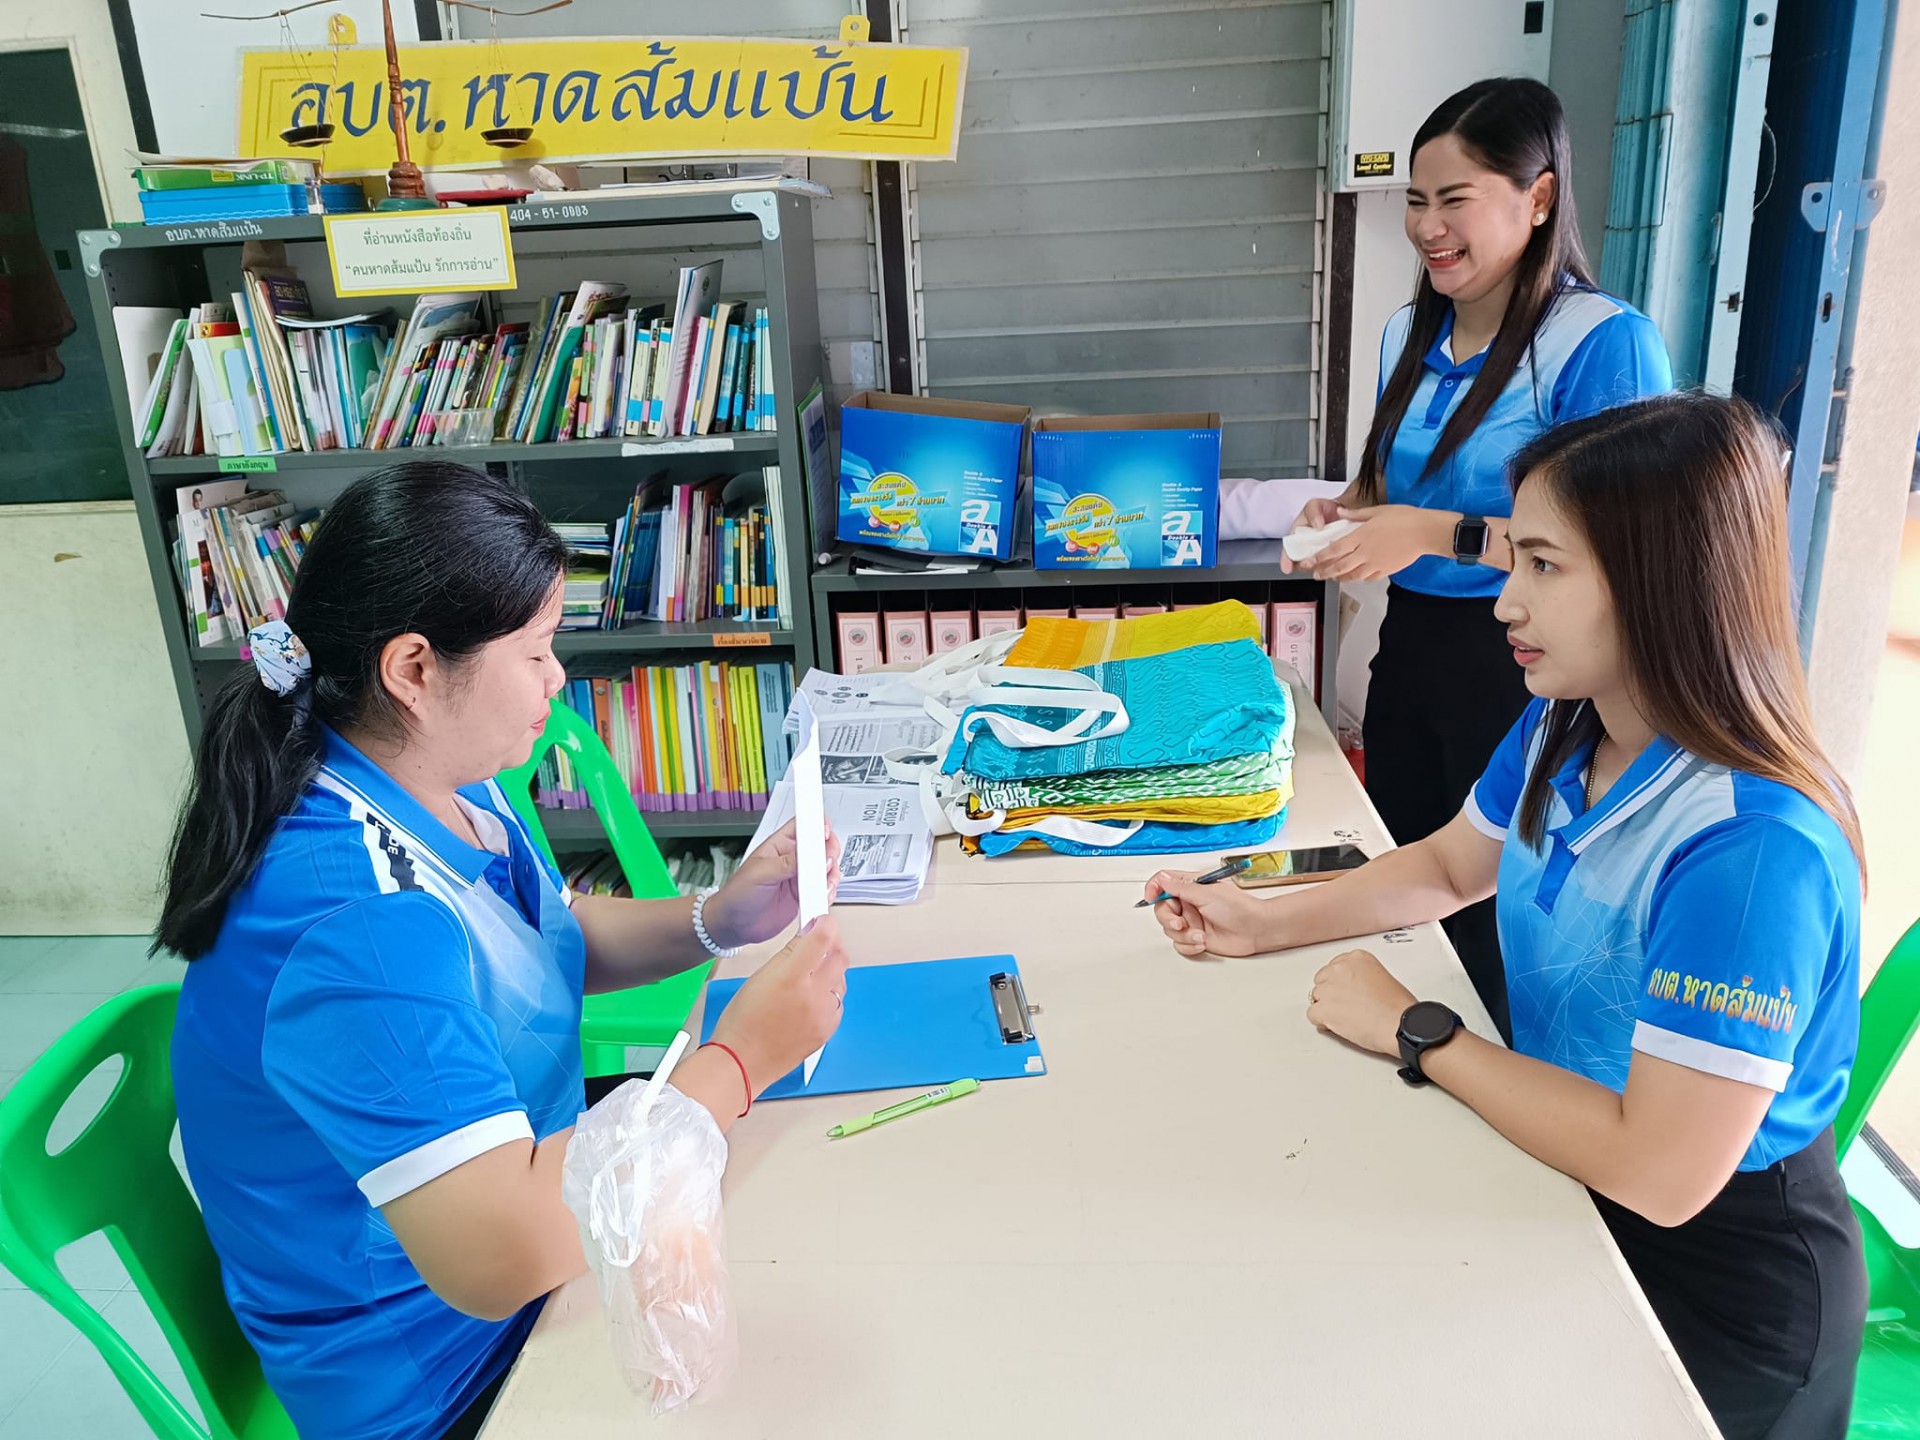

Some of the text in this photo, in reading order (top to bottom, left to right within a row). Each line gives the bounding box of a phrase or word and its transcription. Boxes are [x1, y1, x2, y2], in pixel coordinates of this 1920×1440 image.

[363, 222, 472, 245] ที่อ่านหนังสือท้องถิ่น
[862, 804, 878, 821] TION
[880, 798, 900, 826] CORRUP
